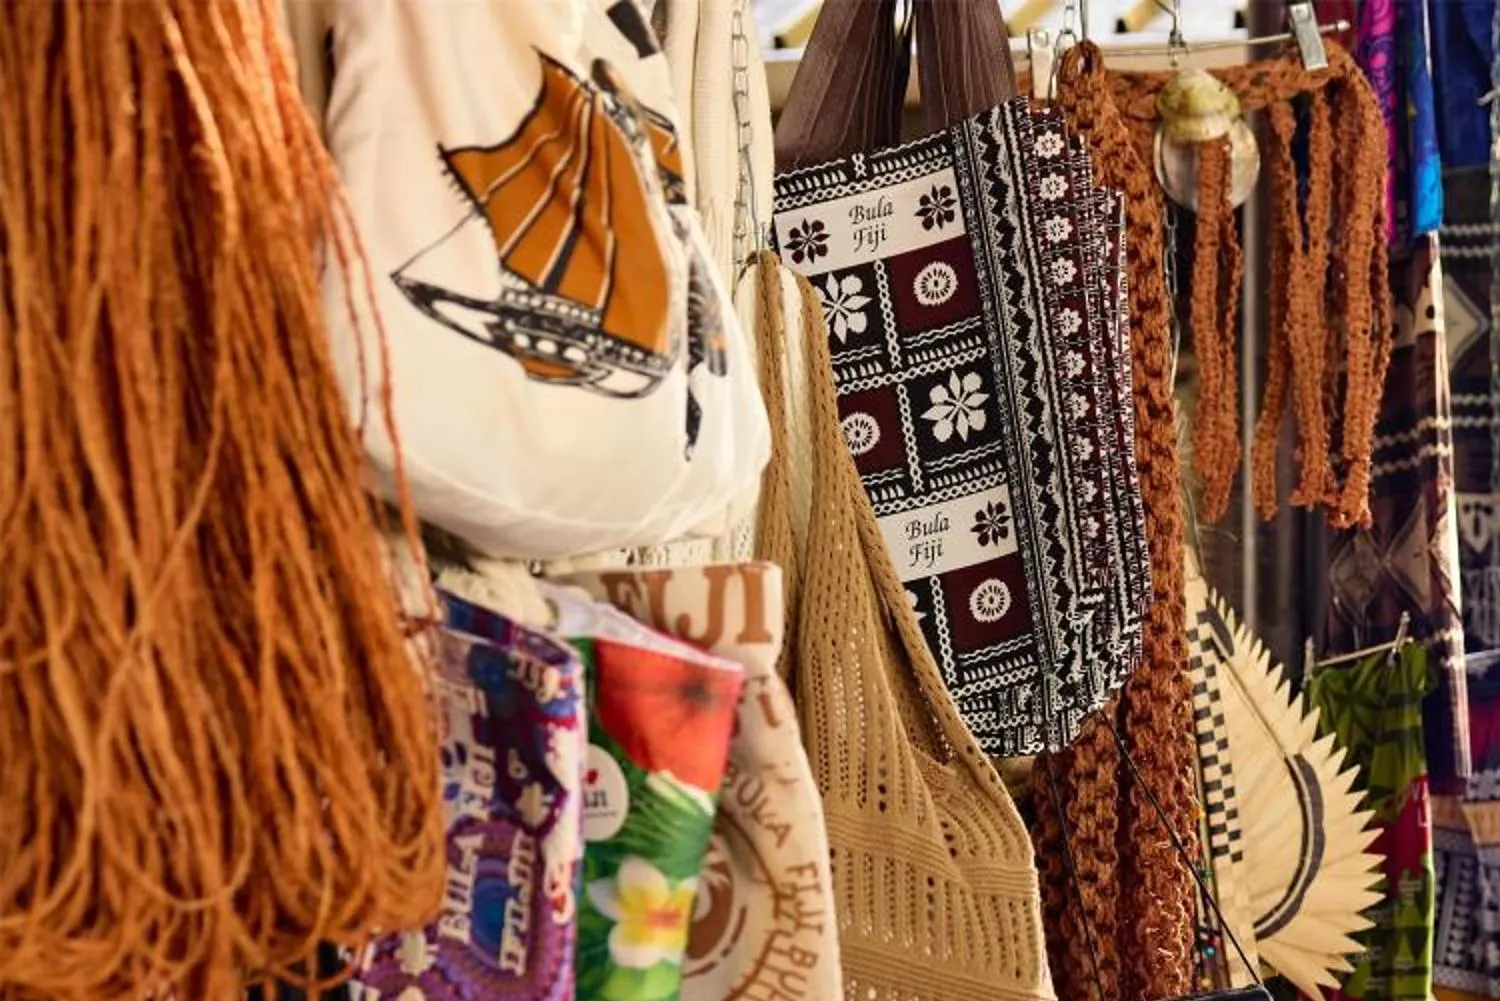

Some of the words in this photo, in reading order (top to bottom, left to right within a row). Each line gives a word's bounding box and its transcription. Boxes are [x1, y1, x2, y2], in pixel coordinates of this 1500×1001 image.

[848, 195, 894, 225] Bula
[853, 222, 886, 253] Fiji
[905, 511, 950, 540] Bula
[909, 538, 944, 568] Fiji
